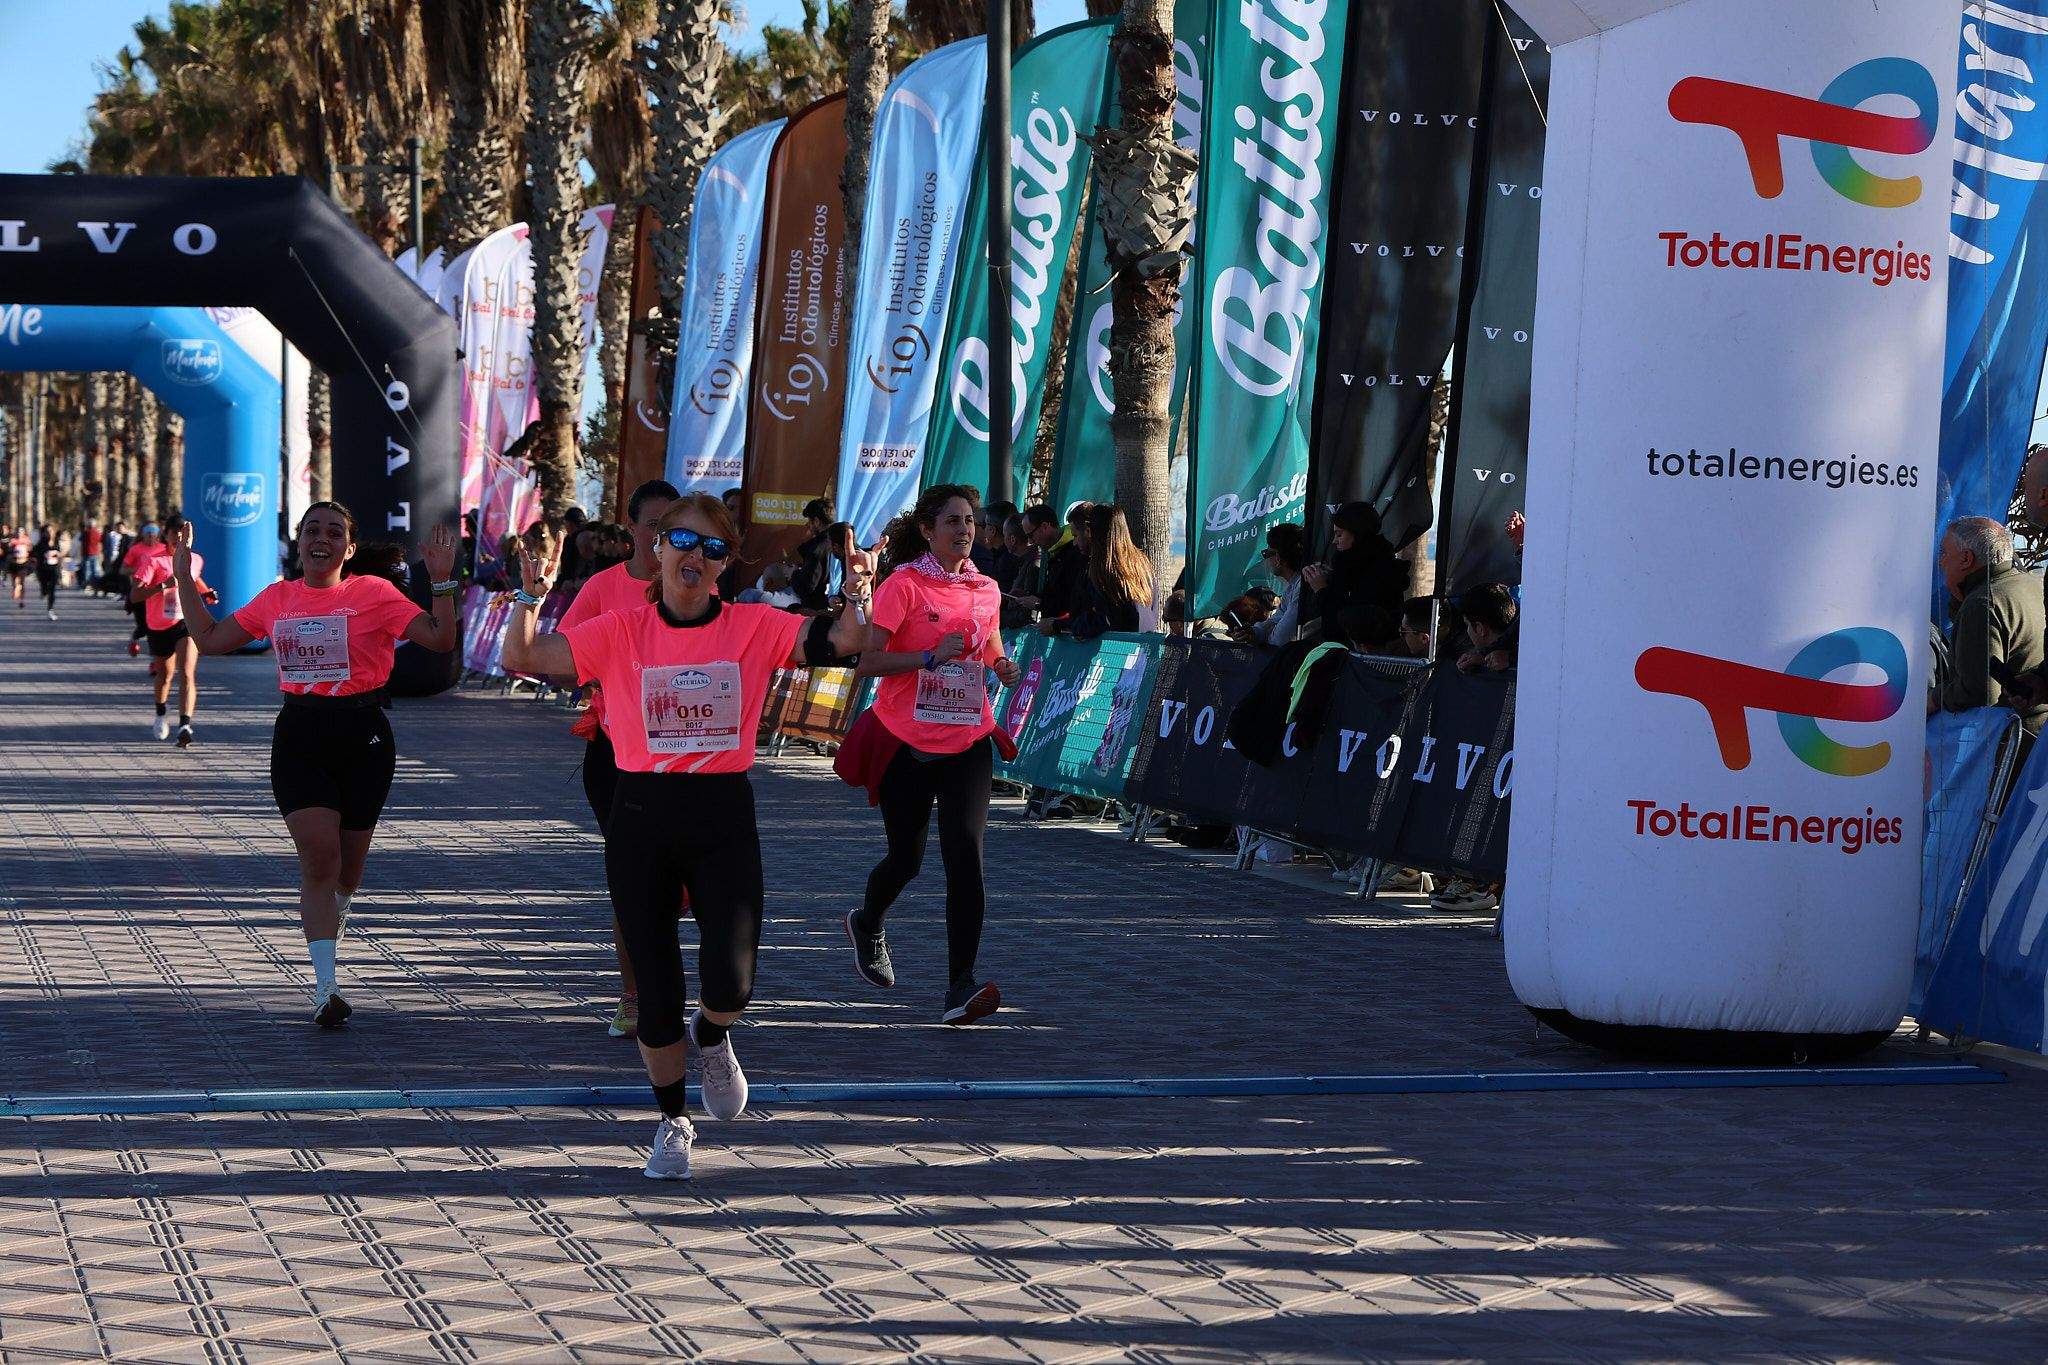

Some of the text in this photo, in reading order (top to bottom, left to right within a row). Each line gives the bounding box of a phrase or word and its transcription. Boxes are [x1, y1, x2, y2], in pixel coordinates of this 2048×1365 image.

[885, 218, 911, 314] Institutos
[908, 171, 938, 317] Odontológicos
[1658, 232, 1931, 287] TotalEnergies
[722, 233, 747, 352] Odontológicos
[780, 249, 803, 344] Institutos
[801, 204, 829, 346] Odontológicos
[706, 272, 727, 351] Institutos
[686, 459, 706, 469] 900
[723, 460, 742, 470] 002
[686, 469, 741, 479] www.ioa.es
[1646, 447, 1919, 489] totalenergies.es
[1206, 472, 1307, 532] Batiste
[1265, 518, 1280, 532] EN
[297, 645, 326, 657] 016
[674, 678, 709, 687] ASTURIANA
[941, 687, 966, 699] 016
[676, 703, 714, 719] 016
[685, 721, 703, 729] 8012
[658, 740, 687, 748] OYSHO
[1339, 728, 1514, 799] VOLVO
[1627, 799, 1904, 855] TotalEnergies
